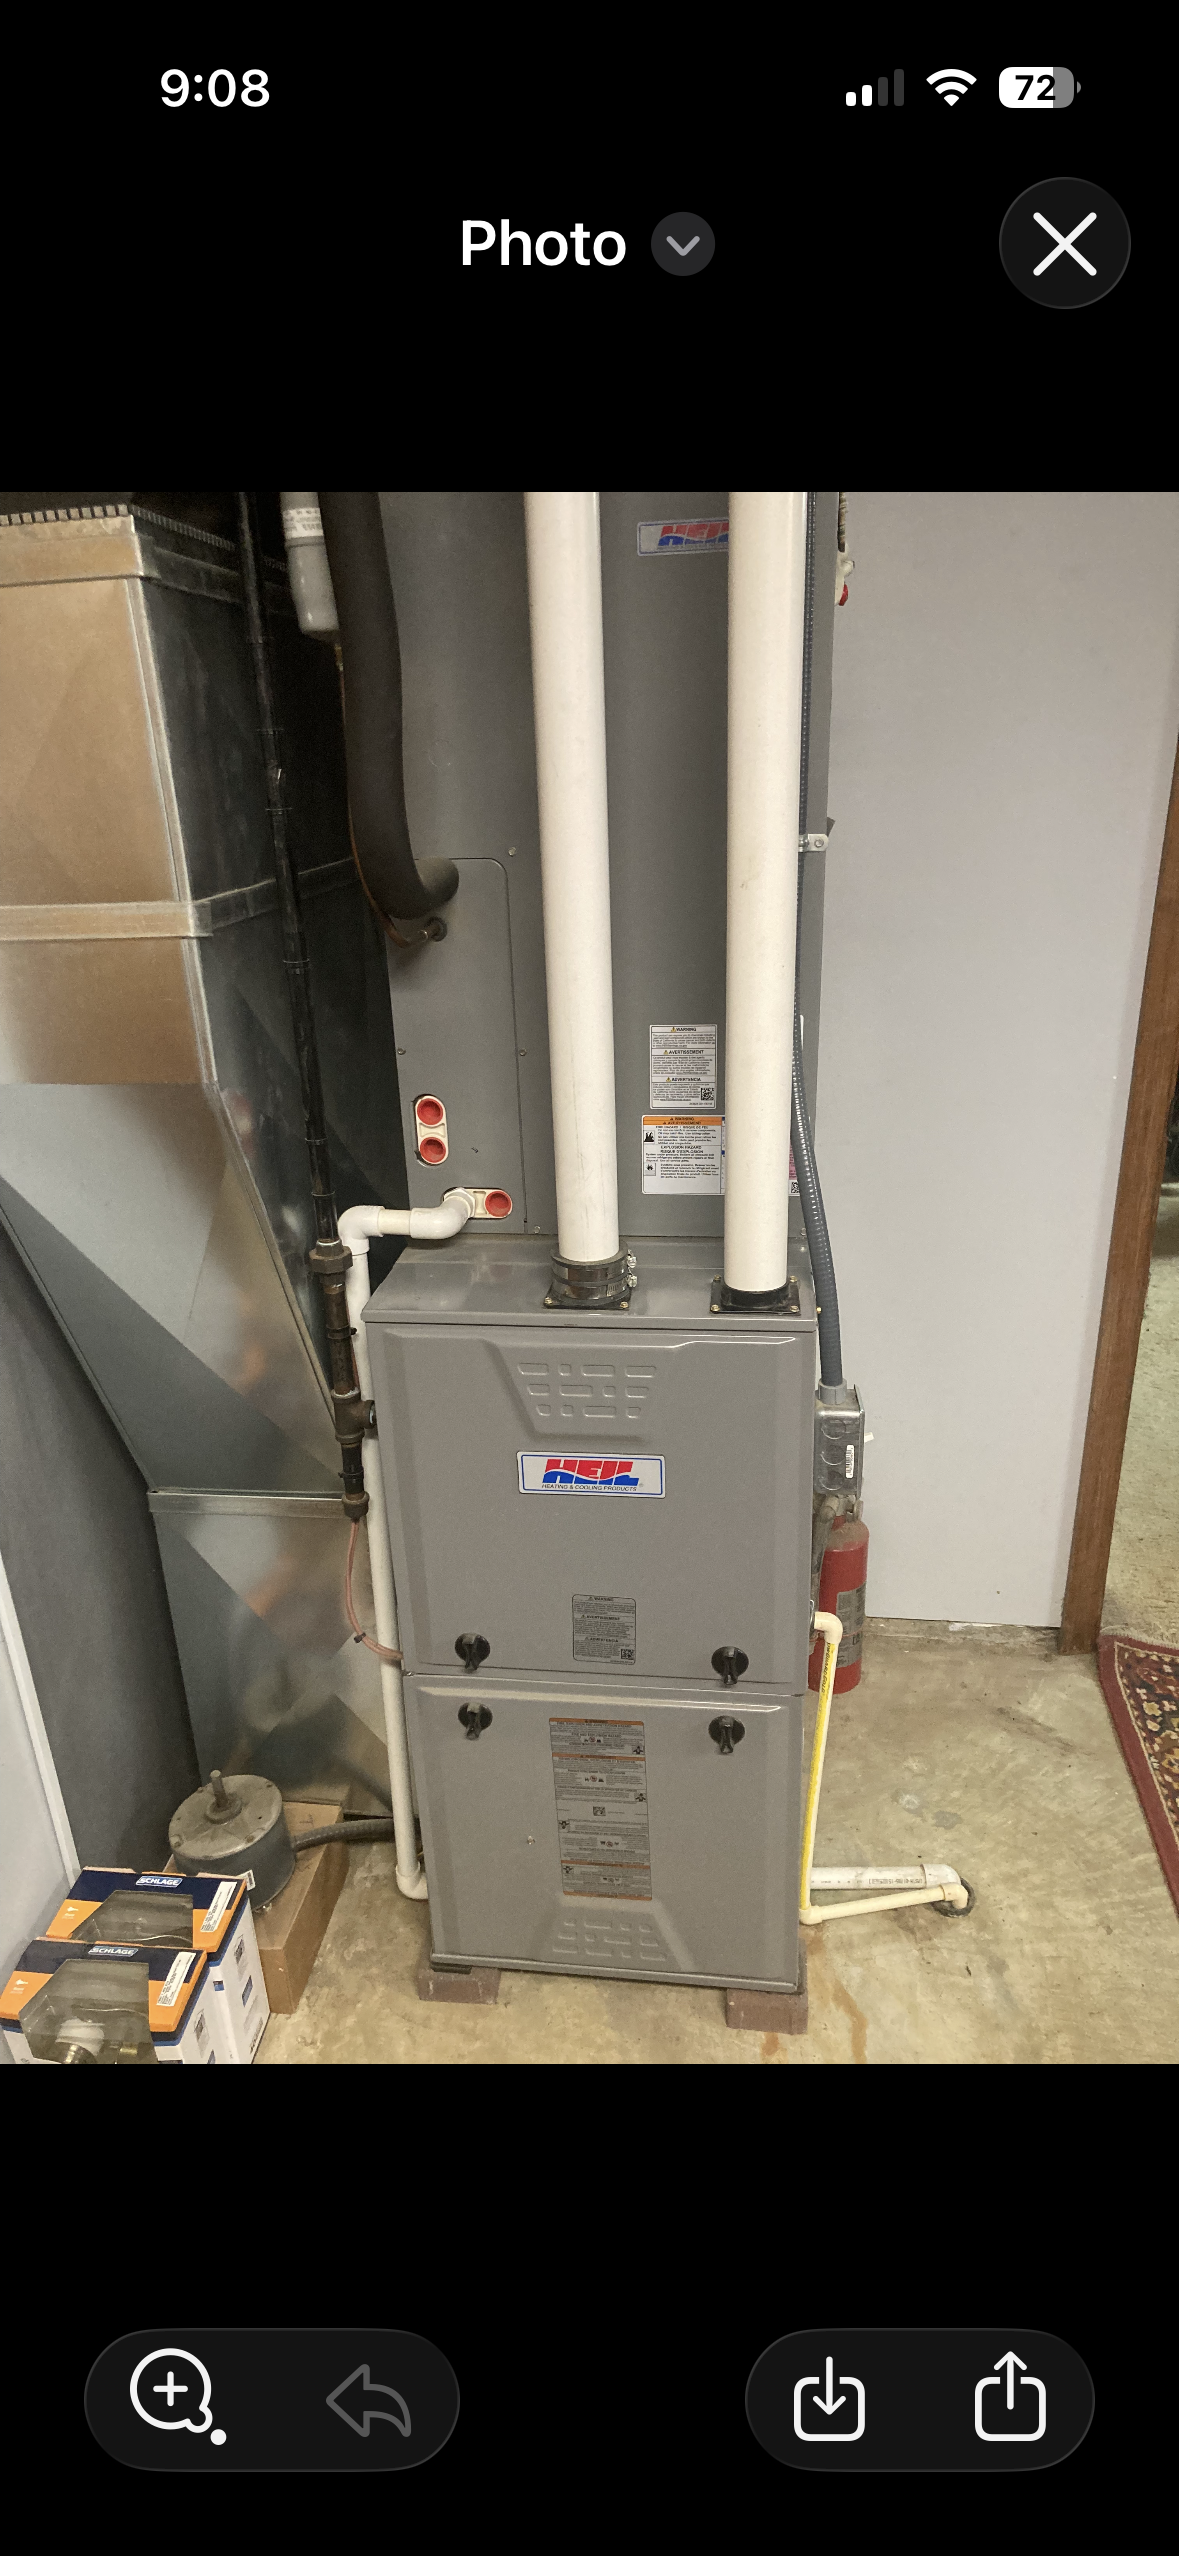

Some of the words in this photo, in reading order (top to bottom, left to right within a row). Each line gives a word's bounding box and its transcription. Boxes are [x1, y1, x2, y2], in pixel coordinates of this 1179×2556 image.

[542, 1459, 639, 1486] HEIL
[139, 1877, 179, 1886] SCHLAGE
[92, 1947, 134, 1955] SCHLAGE
